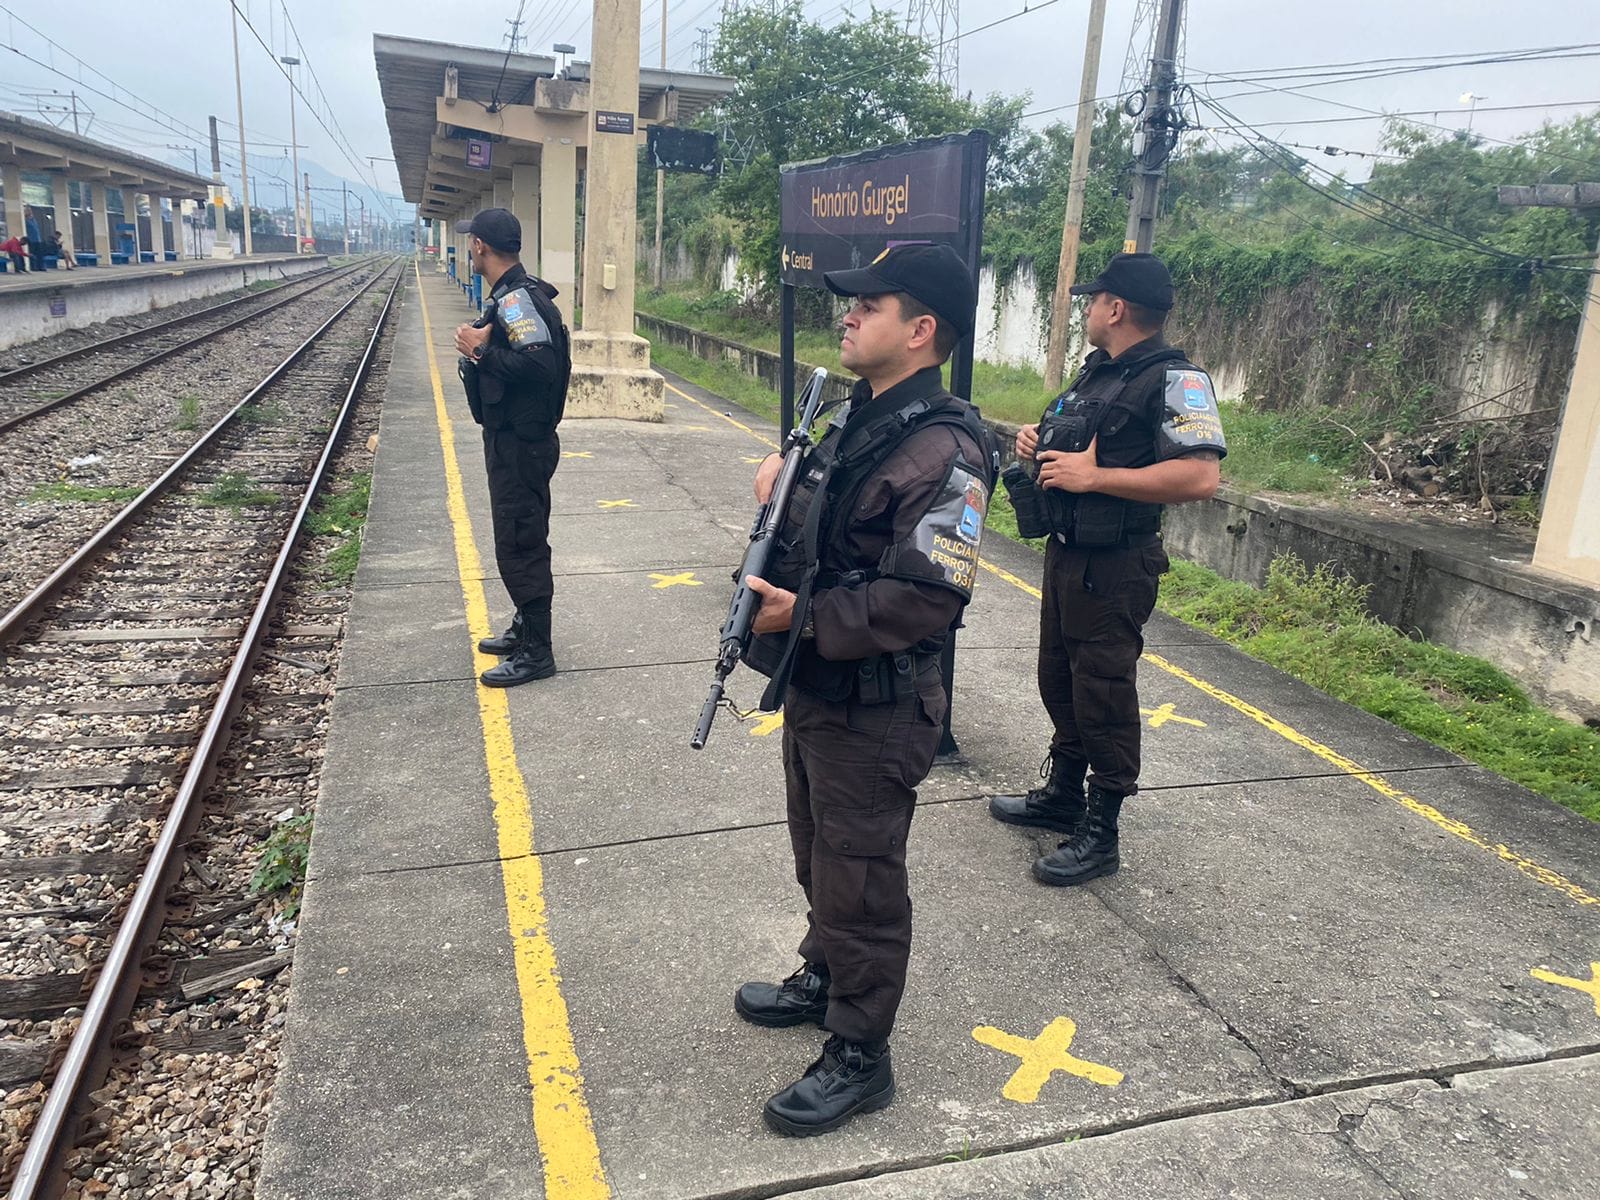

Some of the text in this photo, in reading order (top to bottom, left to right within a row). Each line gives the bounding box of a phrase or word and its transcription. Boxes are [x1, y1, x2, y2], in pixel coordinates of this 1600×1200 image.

[811, 174, 910, 225] Honório Gurgel
[790, 250, 813, 271] Central
[953, 571, 972, 589] 031
